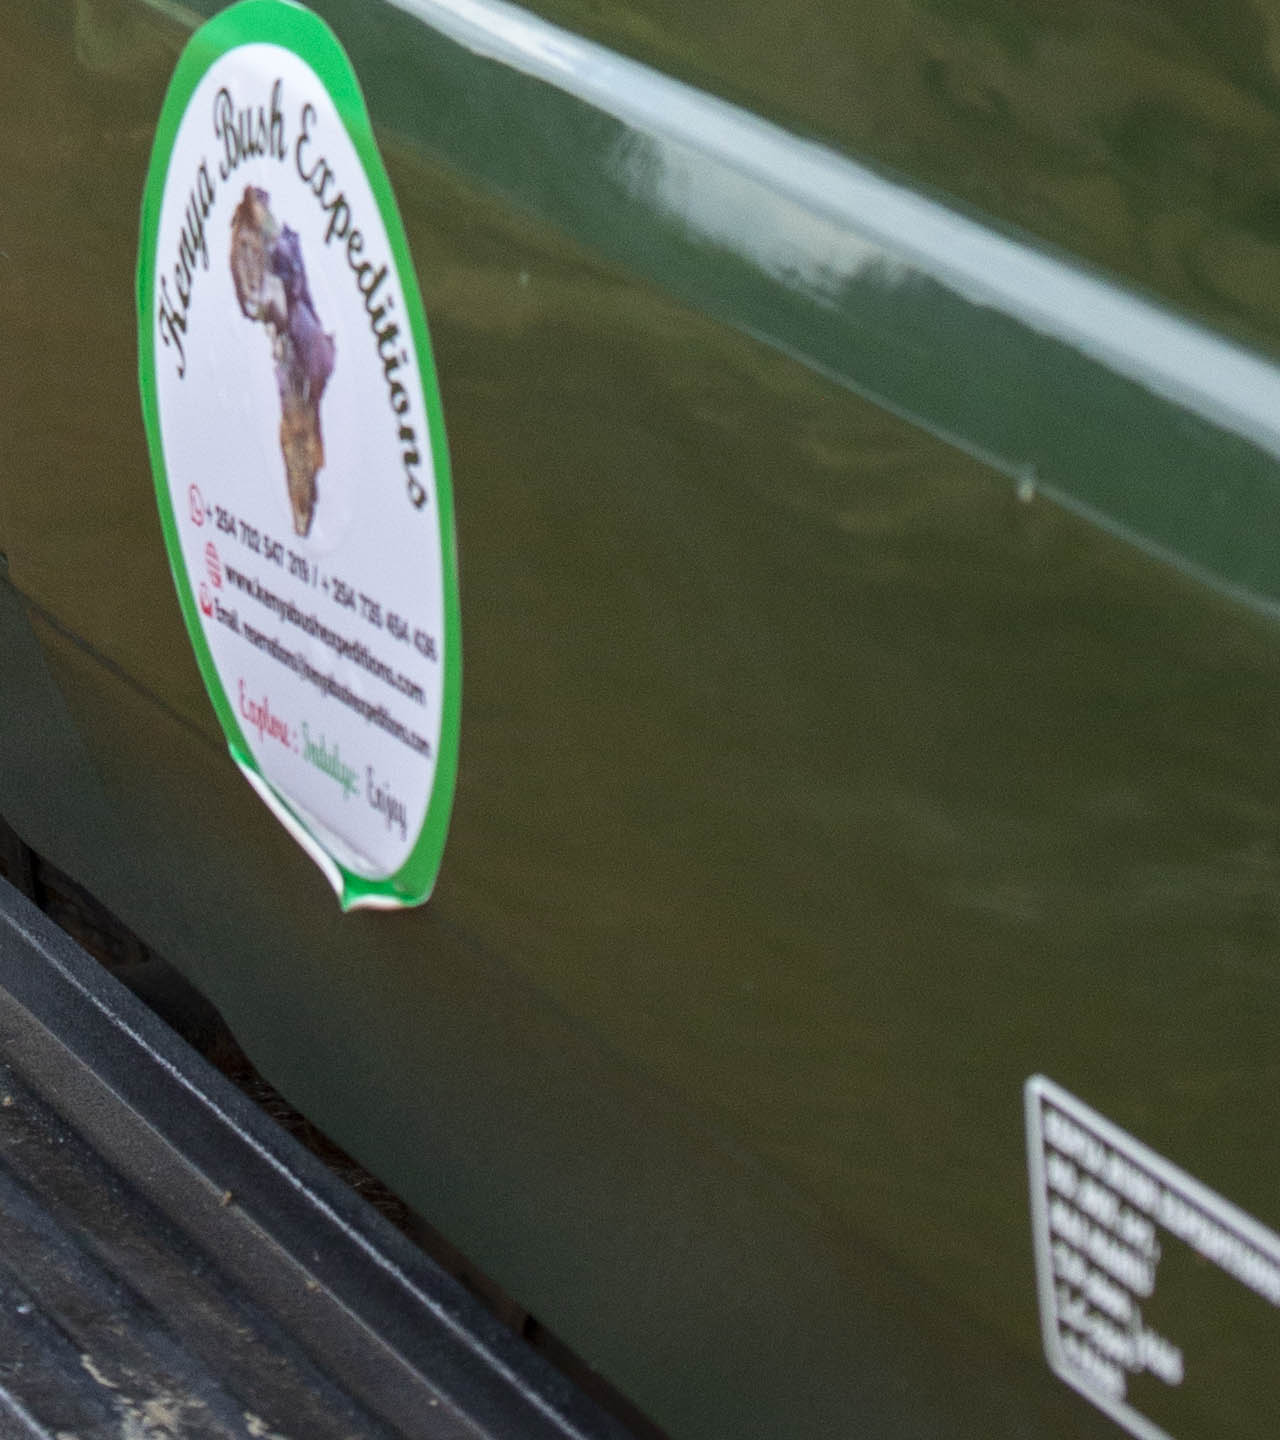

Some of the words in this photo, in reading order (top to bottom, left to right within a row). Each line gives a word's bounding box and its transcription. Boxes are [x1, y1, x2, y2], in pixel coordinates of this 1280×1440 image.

[158, 158, 215, 380] Kenya
[212, 78, 287, 177] Bush
[295, 102, 428, 511] Expeditions
[214, 504, 237, 538] 254
[239, 519, 261, 554] 702
[263, 534, 285, 568] 547
[366, 764, 408, 842] Enjoy
